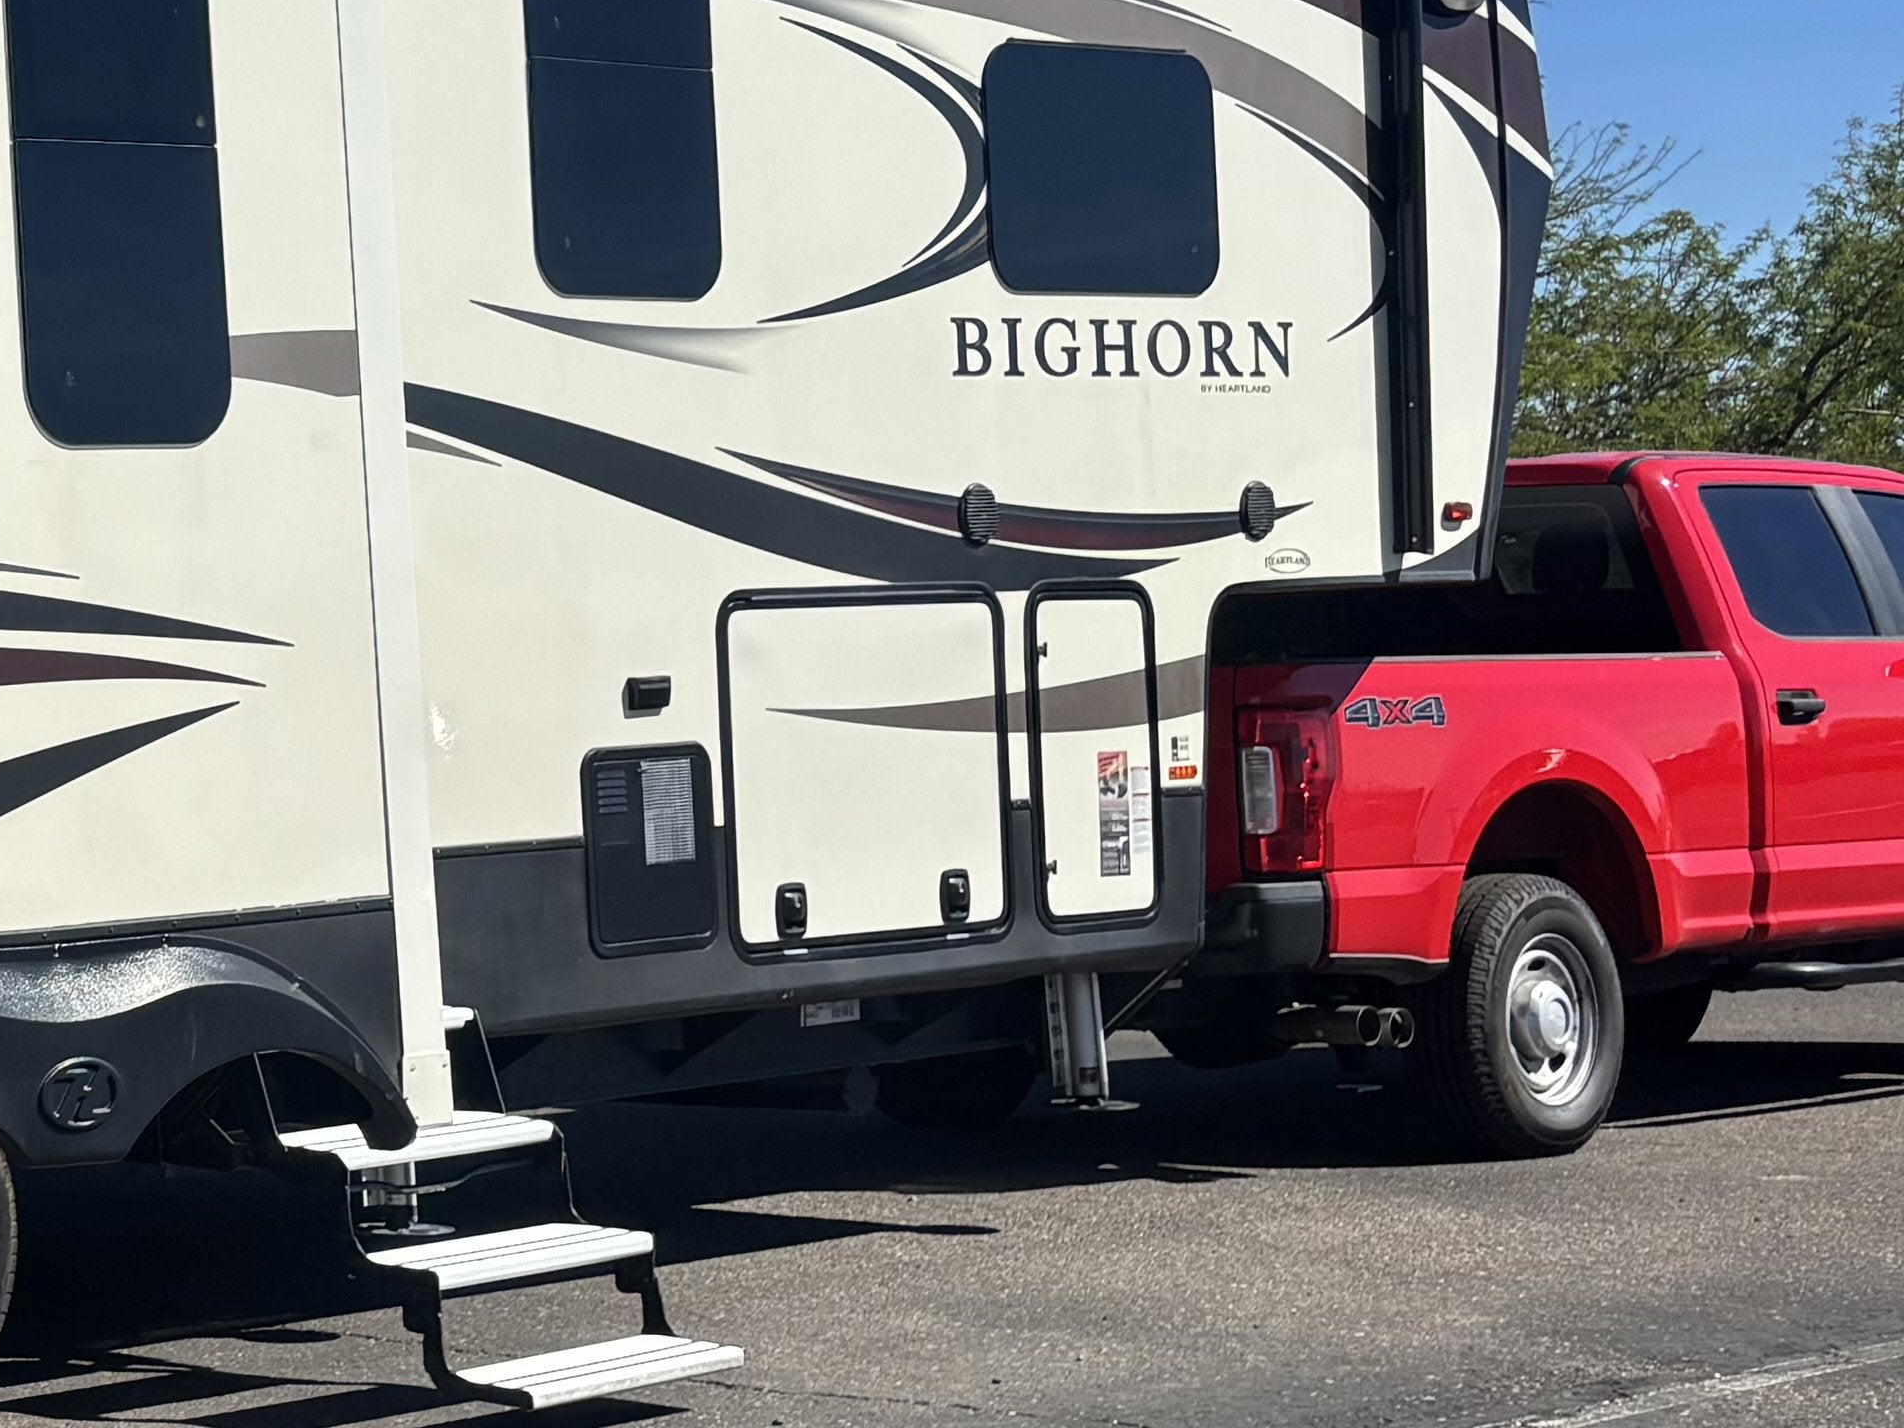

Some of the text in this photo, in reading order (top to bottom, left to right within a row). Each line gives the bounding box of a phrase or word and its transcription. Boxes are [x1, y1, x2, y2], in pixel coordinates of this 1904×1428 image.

[950, 317, 1293, 377] BIGHORN
[1201, 384, 1271, 393] BY HEARTLAND
